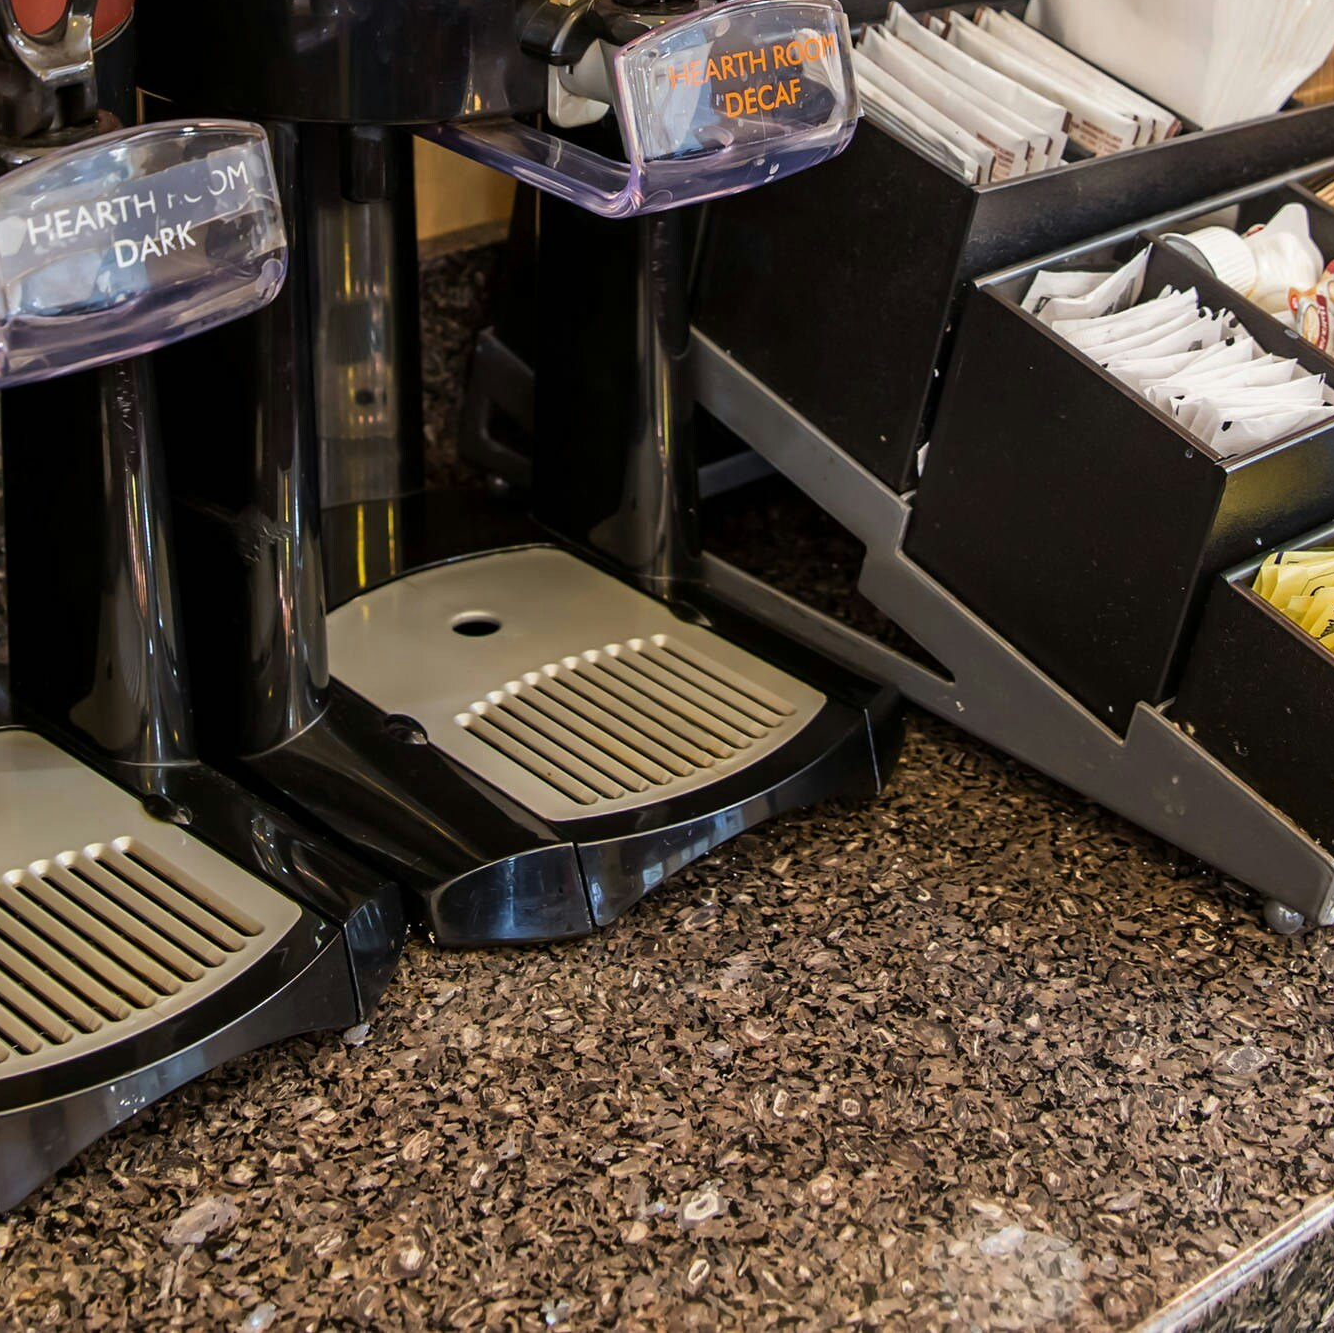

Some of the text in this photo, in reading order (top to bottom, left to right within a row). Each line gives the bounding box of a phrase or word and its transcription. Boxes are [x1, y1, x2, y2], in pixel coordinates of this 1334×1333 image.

[668, 32, 836, 91] HEARTH ROOM
[724, 77, 803, 119] DECAF
[26, 191, 156, 246] HEARTH
[113, 220, 197, 269] DARK
